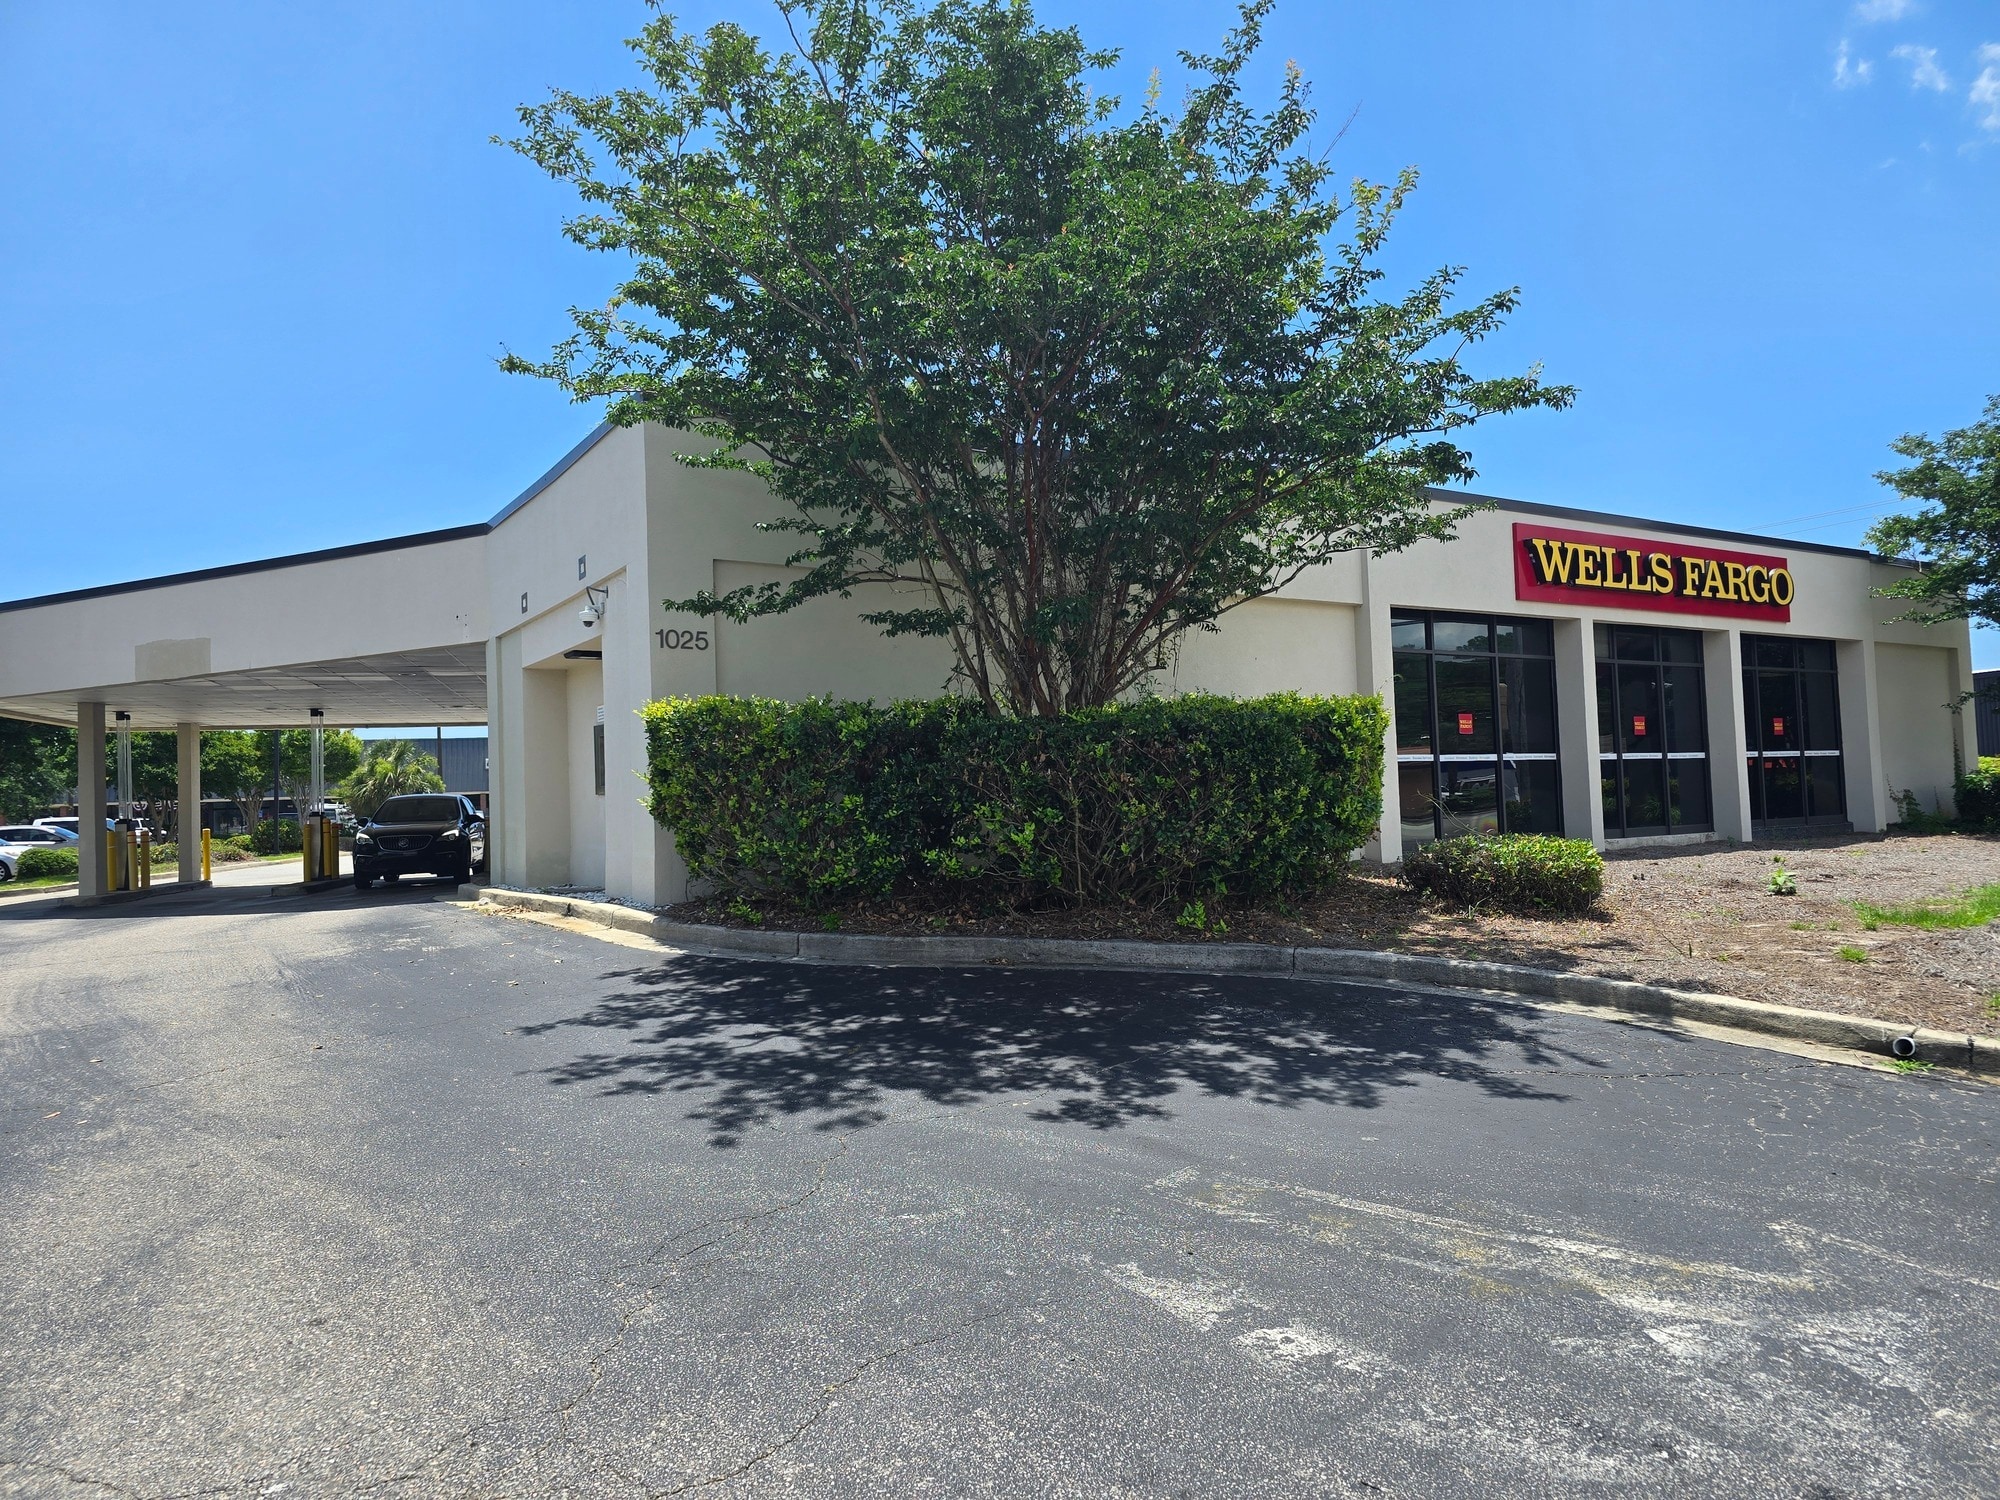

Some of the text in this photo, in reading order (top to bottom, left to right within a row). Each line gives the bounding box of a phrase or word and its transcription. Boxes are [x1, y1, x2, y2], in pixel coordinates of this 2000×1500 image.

[1530, 538, 1794, 606] WELLS FARGO
[655, 629, 709, 651] 1025
